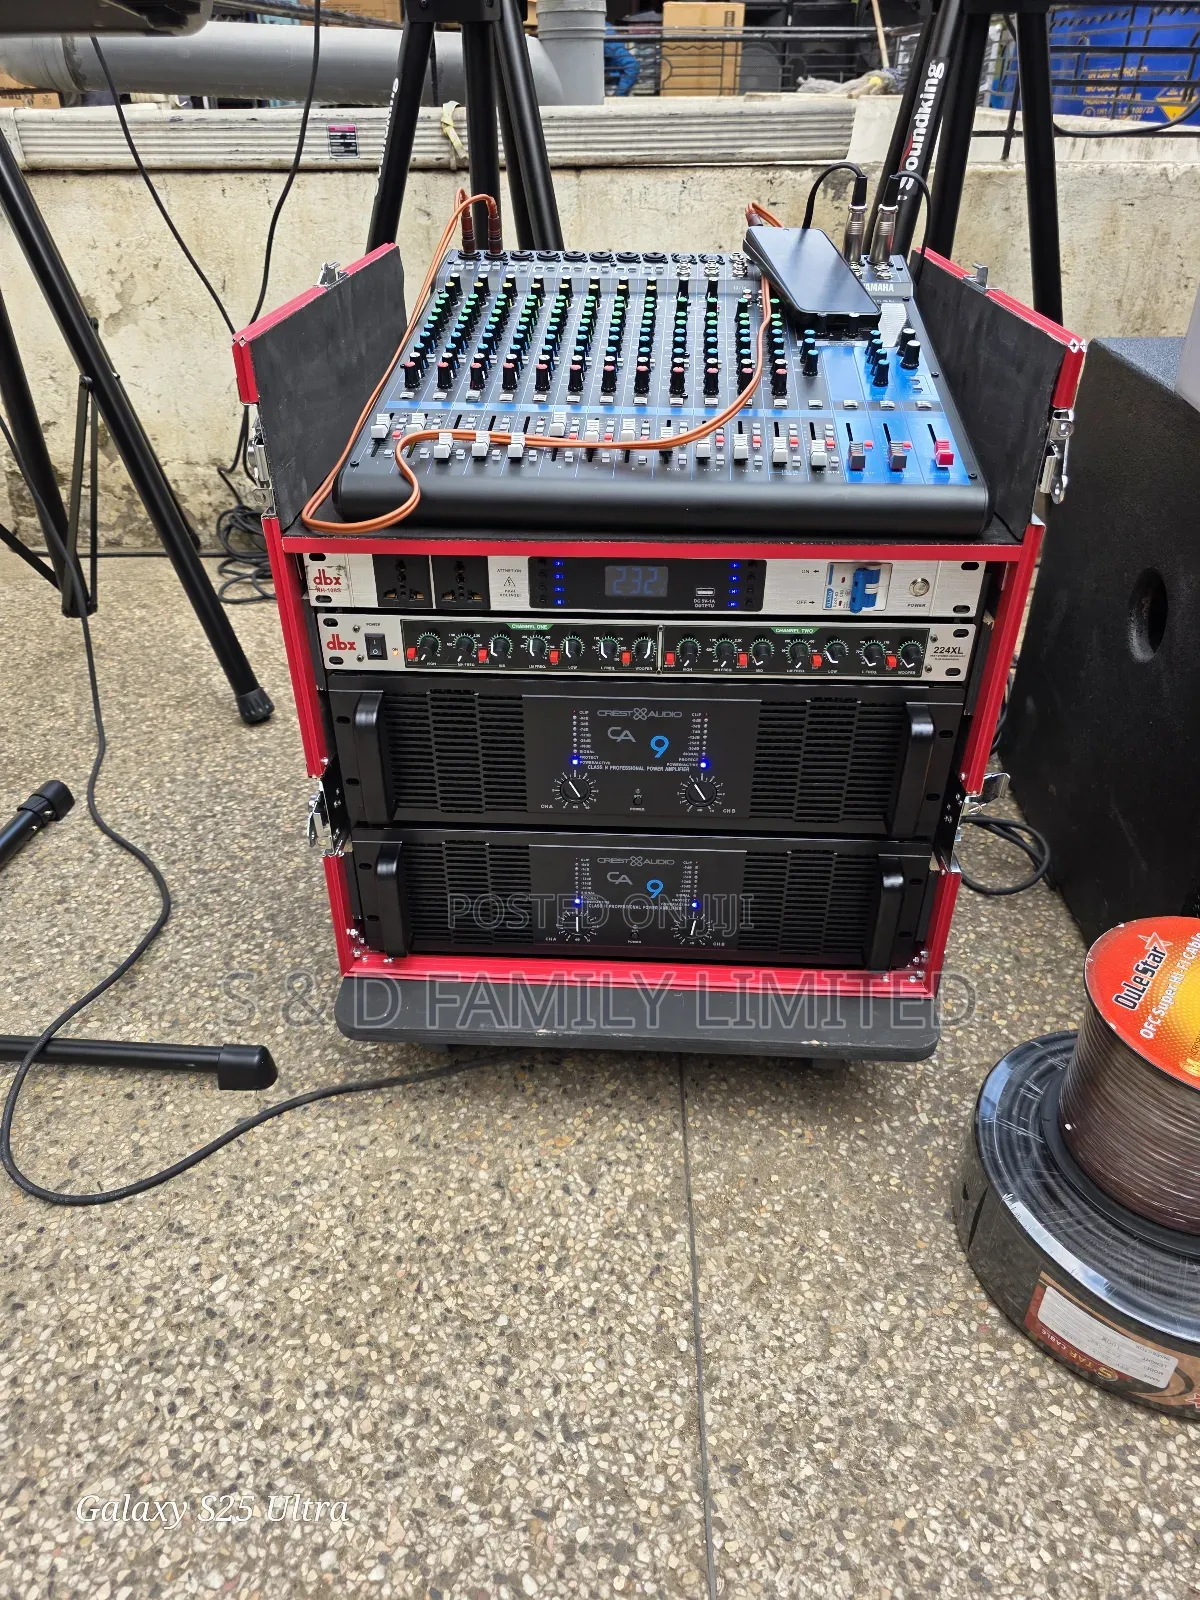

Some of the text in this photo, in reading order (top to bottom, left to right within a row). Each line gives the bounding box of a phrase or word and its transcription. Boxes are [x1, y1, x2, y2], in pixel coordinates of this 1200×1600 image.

[313, 568, 342, 586] dbx
[612, 567, 658, 594] 232
[326, 633, 357, 651] dbx
[933, 646, 964, 654] 224XL
[597, 709, 634, 717] CREST
[607, 726, 636, 743] CA
[650, 735, 670, 759] 9
[596, 857, 675, 866] CREST AUDIO
[607, 871, 633, 885] CA
[646, 879, 664, 899] 9
[1140, 1014, 1162, 1039] OFC
[1152, 983, 1179, 1017] Super
